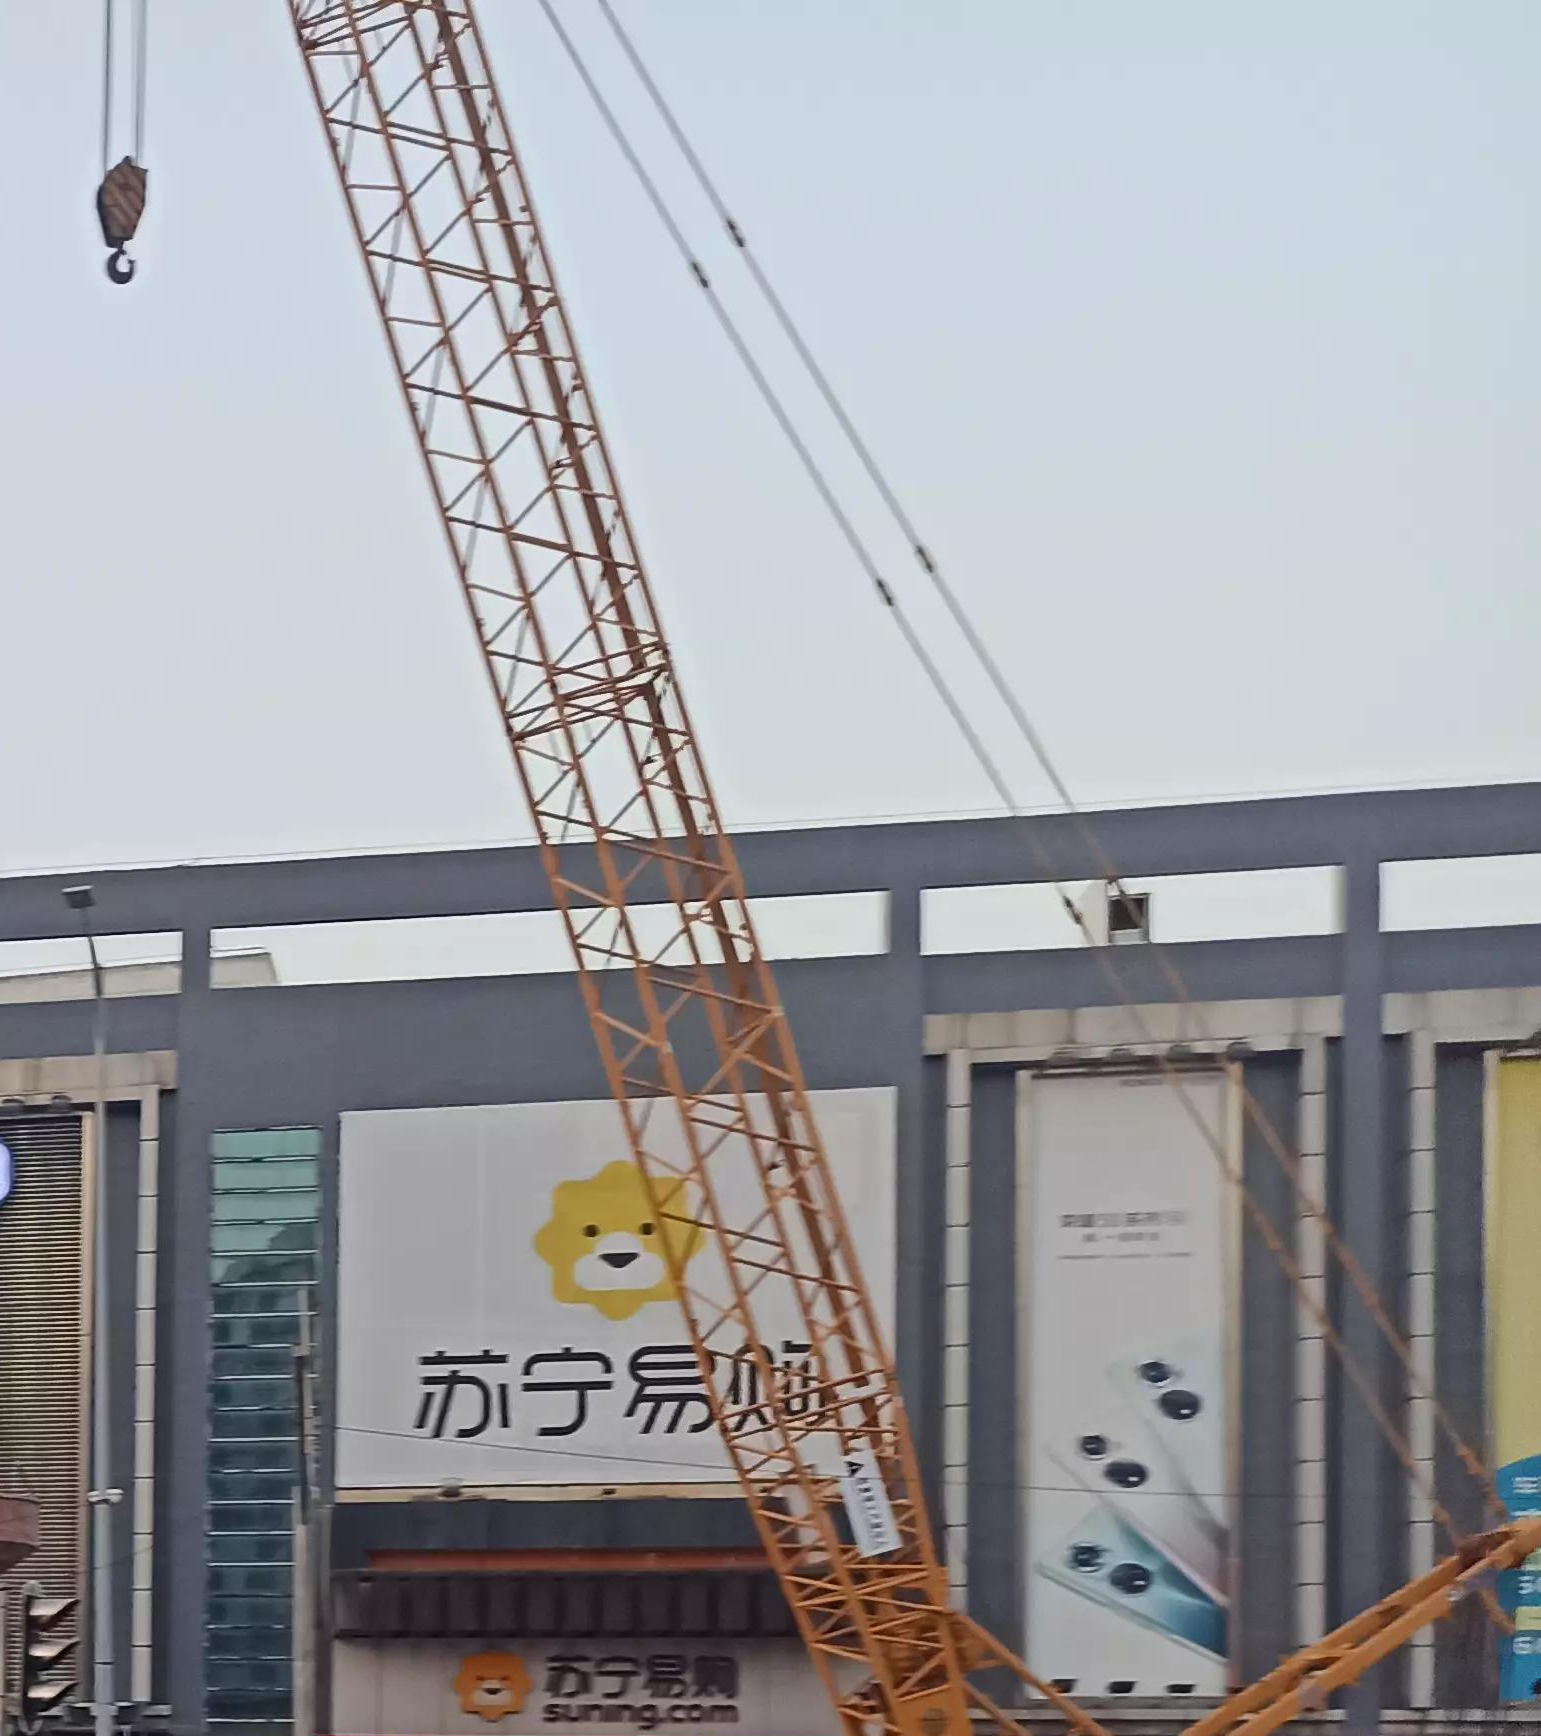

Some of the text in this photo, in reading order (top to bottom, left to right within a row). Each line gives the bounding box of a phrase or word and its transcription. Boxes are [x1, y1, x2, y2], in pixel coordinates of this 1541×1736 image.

[544, 1654, 740, 1699] 苏宁易购
[542, 1702, 740, 1731] suning.com
